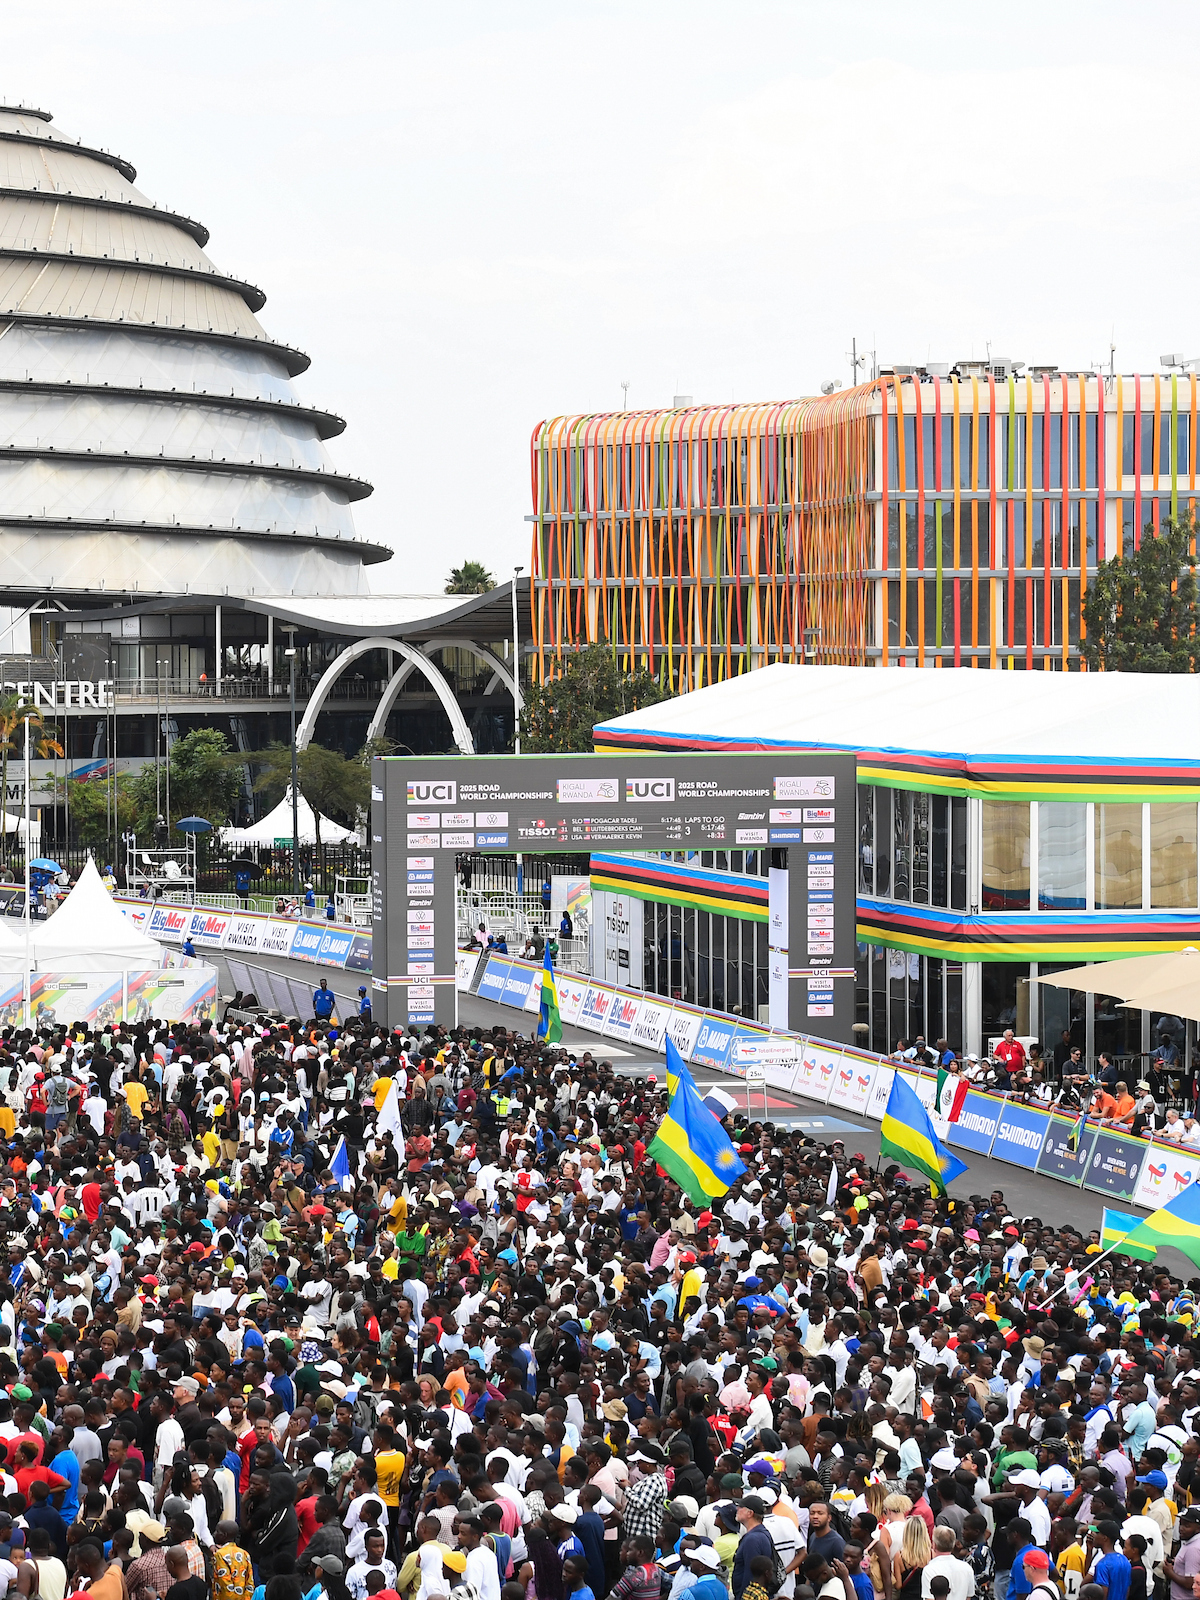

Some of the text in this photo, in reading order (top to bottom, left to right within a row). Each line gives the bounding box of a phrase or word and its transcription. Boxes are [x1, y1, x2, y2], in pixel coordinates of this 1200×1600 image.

[416, 786, 452, 800] UCI
[460, 791, 553, 800] WORLD CHAMPIONSHIPS
[634, 783, 670, 797] UCI
[708, 789, 770, 797] CHAMPIONSHIPS
[807, 810, 831, 818] BigMat
[518, 828, 557, 836] TISSOT
[685, 826, 691, 835] 3
[487, 836, 506, 844] MAPEI
[152, 911, 186, 930] BigMat
[190, 915, 226, 934] BigMat
[237, 922, 256, 933] VISIT
[272, 927, 288, 938] VISIT
[303, 932, 321, 947] MAPEI
[228, 934, 257, 948] RWANDA
[263, 938, 288, 951] RWANDA
[330, 937, 349, 953] MAPEI
[482, 973, 504, 989] SHIMANO
[505, 978, 530, 995] SHIMANO
[584, 988, 610, 1015] BigMat
[610, 998, 636, 1024] BigMat
[643, 1008, 660, 1024] VISIT
[634, 1022, 660, 1043] RWANDA
[674, 1018, 691, 1034] VISIT
[706, 1030, 730, 1052] MAPEI
[999, 1122, 1042, 1149] SHIMANO
[146, 1196, 157, 1211] 11
